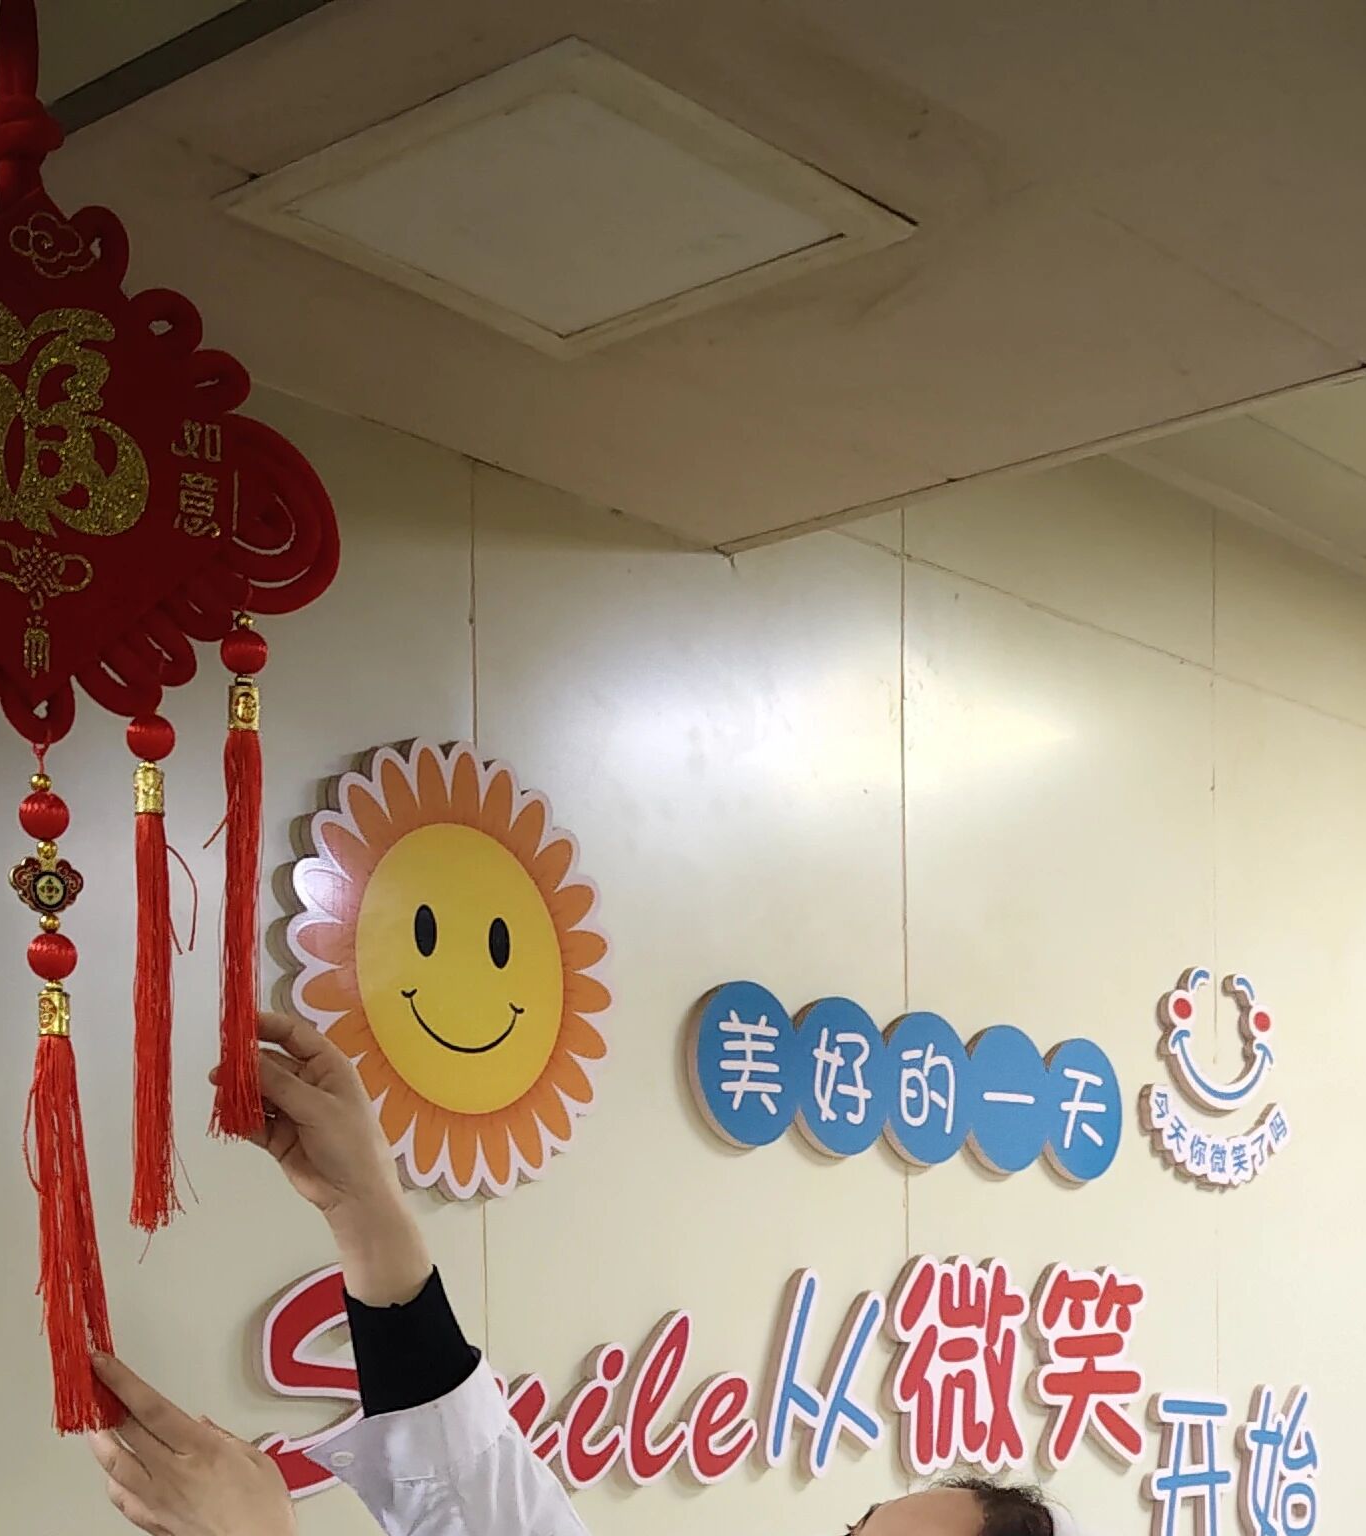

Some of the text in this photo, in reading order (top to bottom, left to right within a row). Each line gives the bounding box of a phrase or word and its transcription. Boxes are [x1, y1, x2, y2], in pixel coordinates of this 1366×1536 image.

[719, 1011, 1106, 1147] 美好的一天
[1155, 1092, 1288, 1174] 今天你微笑了吗
[263, 1262, 757, 1494] Sile
